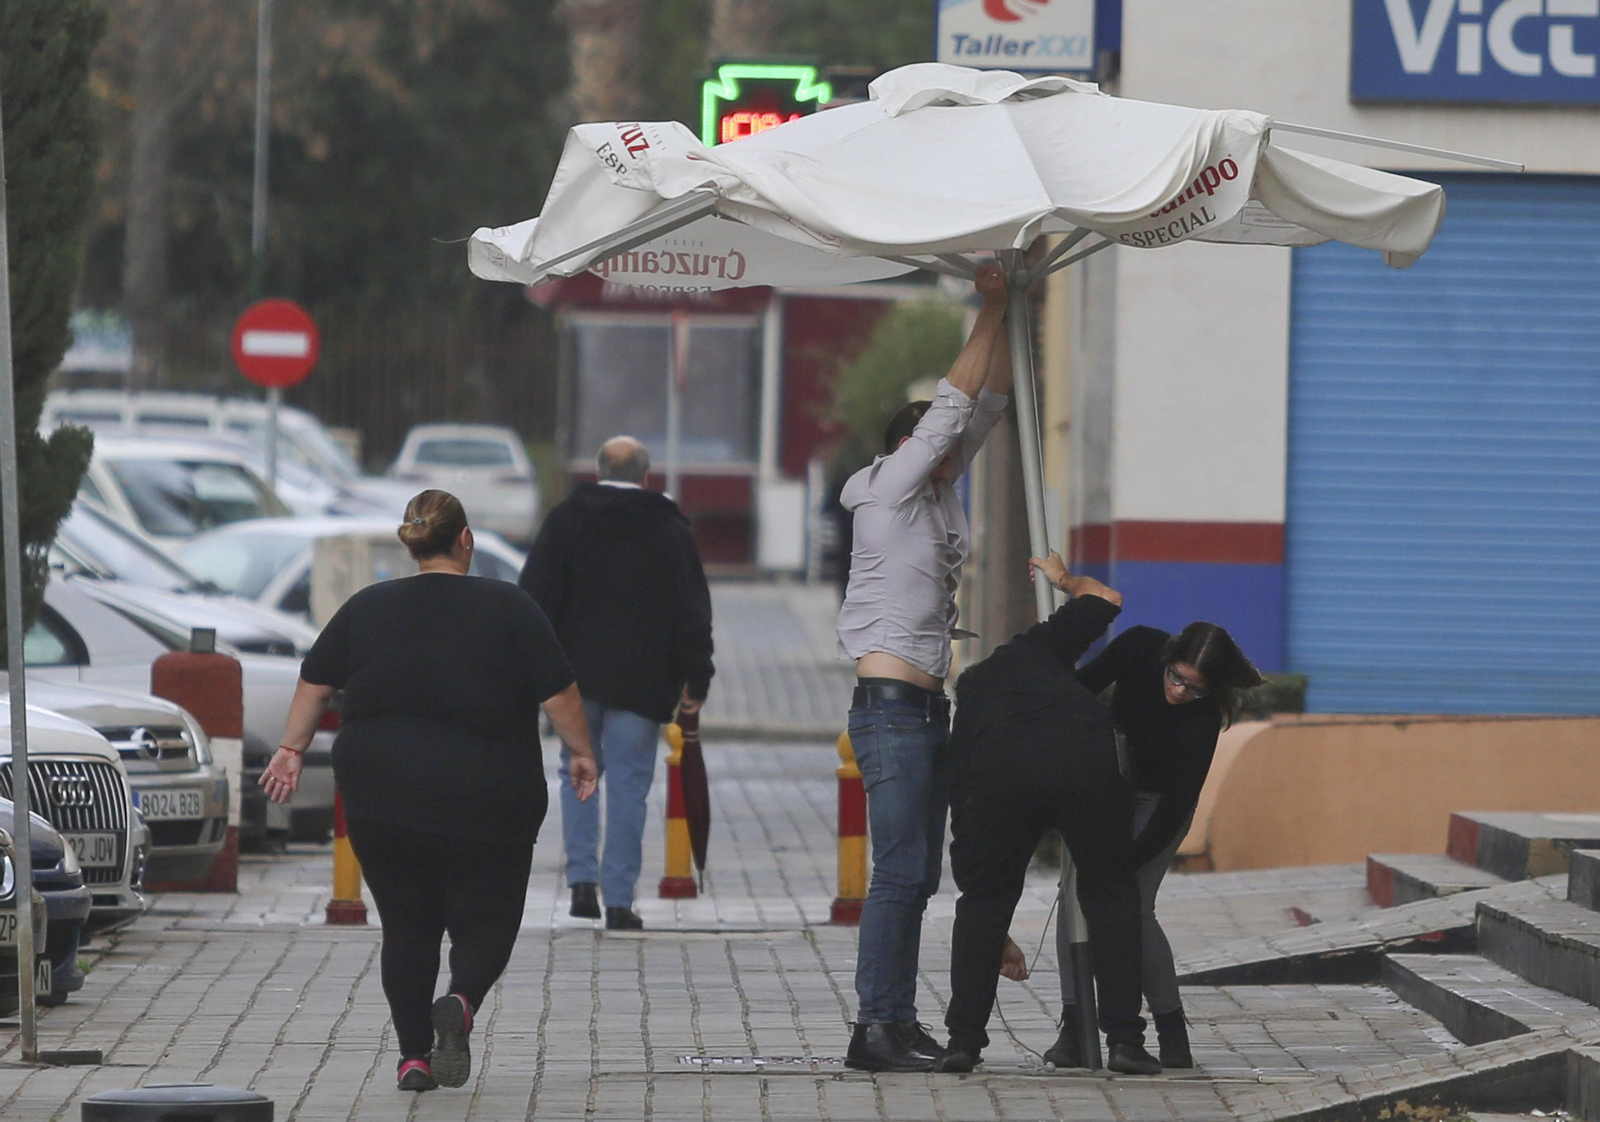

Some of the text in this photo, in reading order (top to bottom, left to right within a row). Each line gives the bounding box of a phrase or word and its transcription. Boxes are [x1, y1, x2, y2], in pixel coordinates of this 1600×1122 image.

[951, 33, 1088, 57] TallerXXI
[1120, 205, 1217, 248] ESPECIAL
[141, 794, 176, 817] 8024
